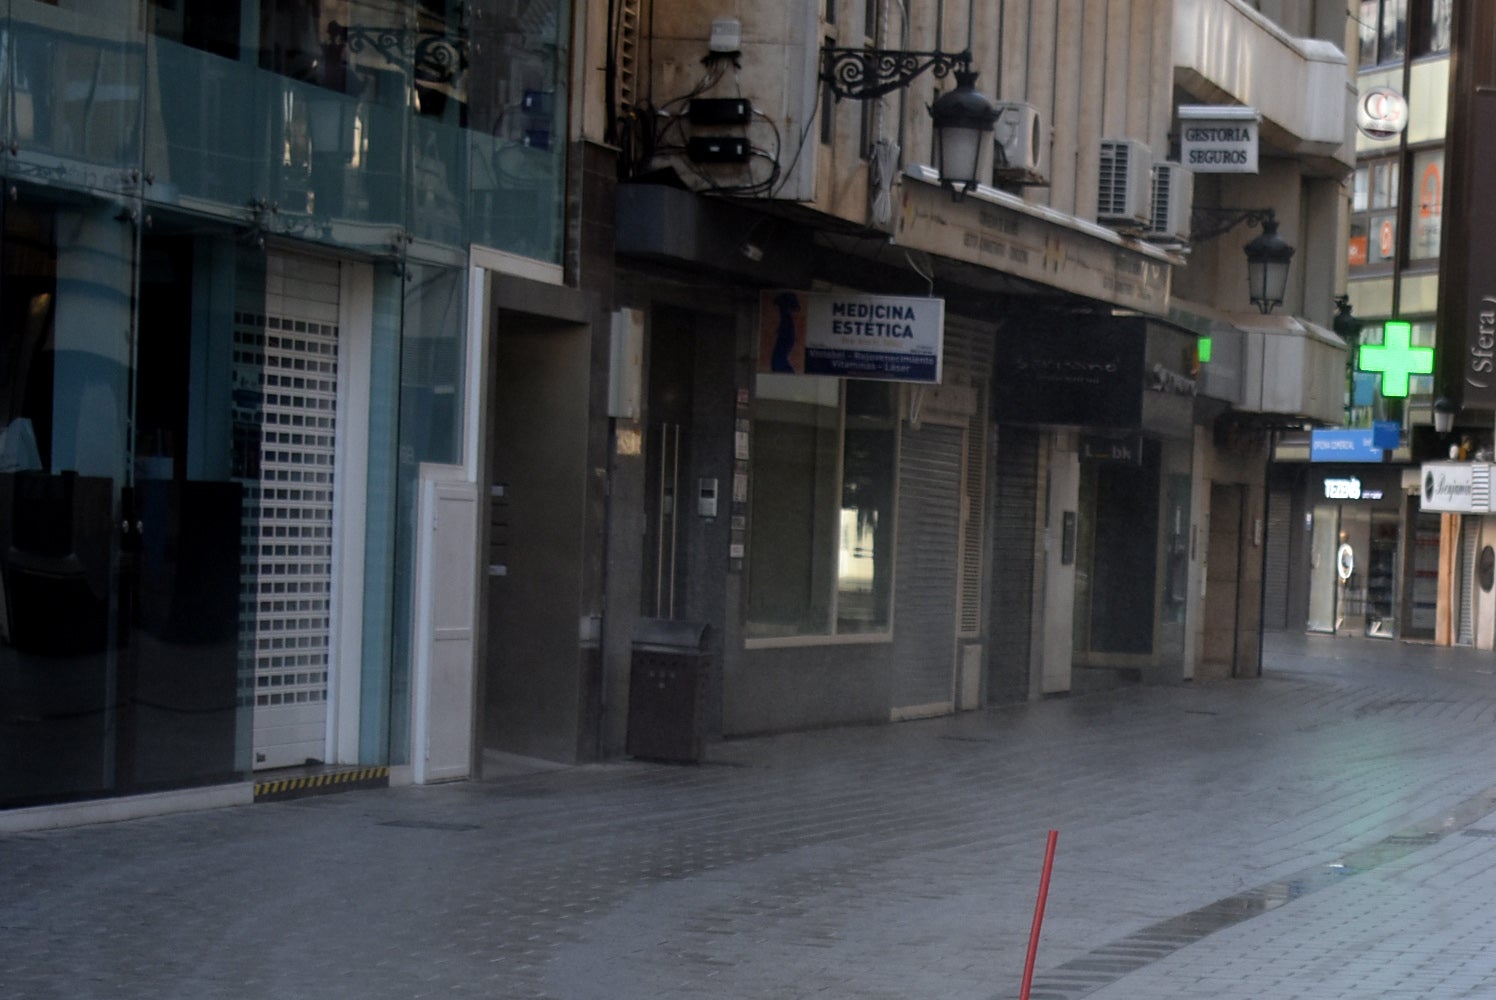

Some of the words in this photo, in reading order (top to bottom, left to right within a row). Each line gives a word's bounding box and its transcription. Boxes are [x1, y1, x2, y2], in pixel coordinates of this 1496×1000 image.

[1185, 128, 1250, 142] GESTORIA
[1189, 150, 1248, 164] SEGUROS
[832, 302, 916, 321] MEDICINA
